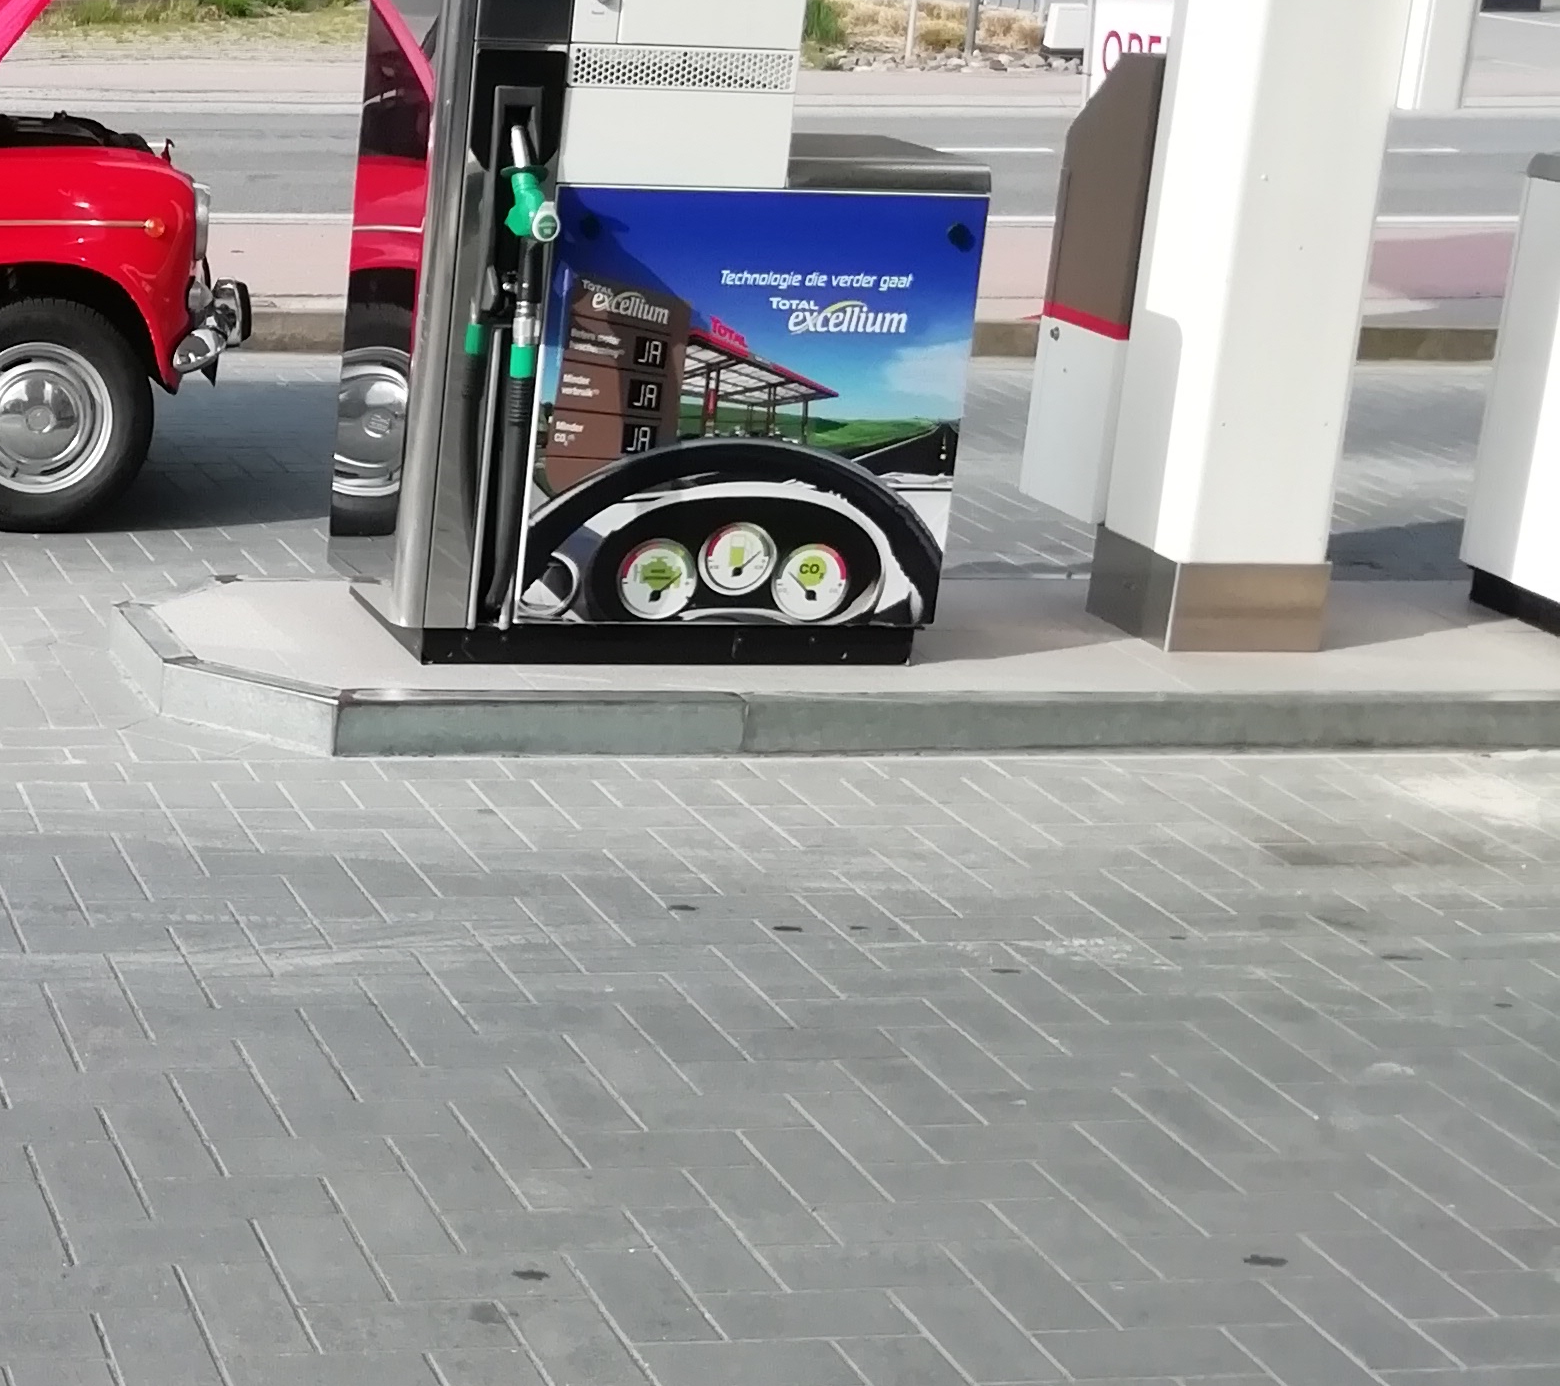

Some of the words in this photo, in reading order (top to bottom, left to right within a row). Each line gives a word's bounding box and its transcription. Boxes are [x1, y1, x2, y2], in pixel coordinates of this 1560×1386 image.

[720, 269, 801, 290] Technologie
[805, 271, 828, 287] die
[831, 273, 877, 288] verder
[878, 272, 914, 292] gaat
[592, 292, 669, 325] excellium
[769, 297, 820, 311] TOTAL
[788, 306, 908, 334] excellium
[638, 340, 662, 365] JA
[633, 384, 657, 409] JA
[626, 426, 651, 453] JA
